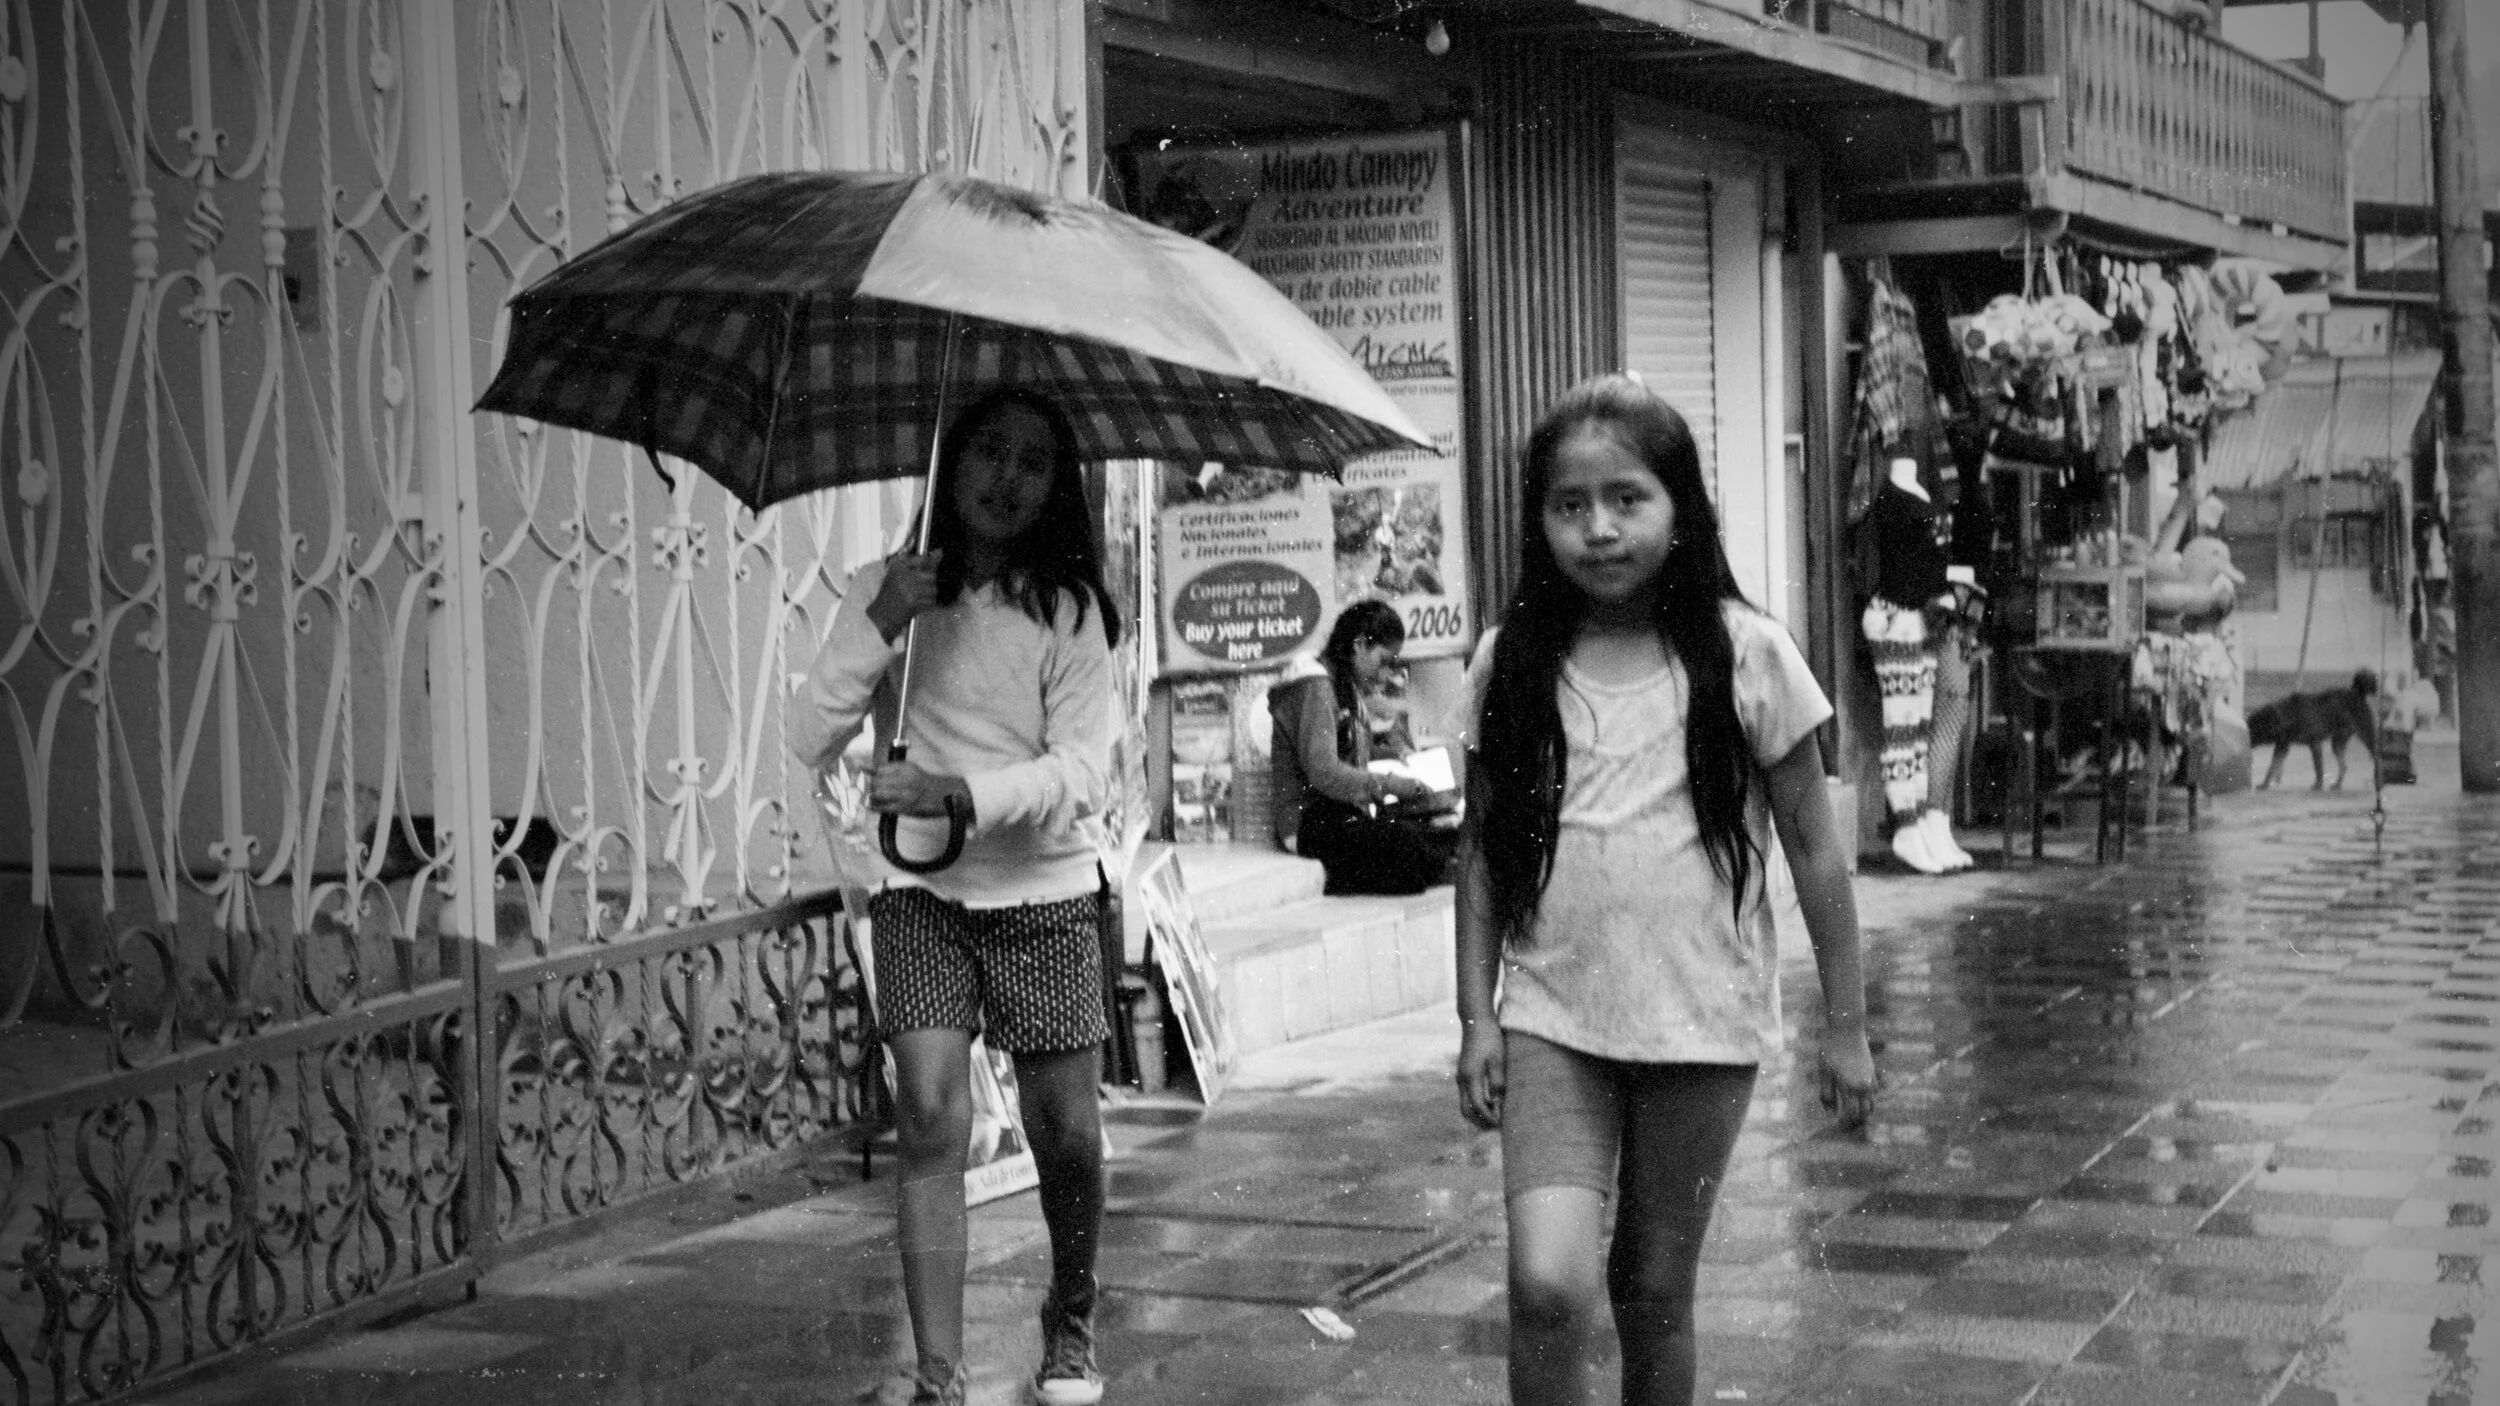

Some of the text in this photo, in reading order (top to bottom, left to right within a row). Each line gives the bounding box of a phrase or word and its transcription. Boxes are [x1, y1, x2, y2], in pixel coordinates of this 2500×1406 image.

[1260, 145, 1439, 192] Mindo Canopy
[1272, 193, 1424, 222] Adventure
[1326, 223, 1340, 245] AL
[1320, 250, 1363, 272] SAFETY
[1300, 276, 1323, 301] de
[1329, 274, 1383, 299] doble
[1388, 271, 1441, 297] cable
[1362, 301, 1442, 330] system
[1190, 580, 1256, 600] Compre
[1185, 615, 1303, 643] Buy your ticket
[1408, 604, 1462, 639] 2006
[1228, 641, 1263, 661] here
